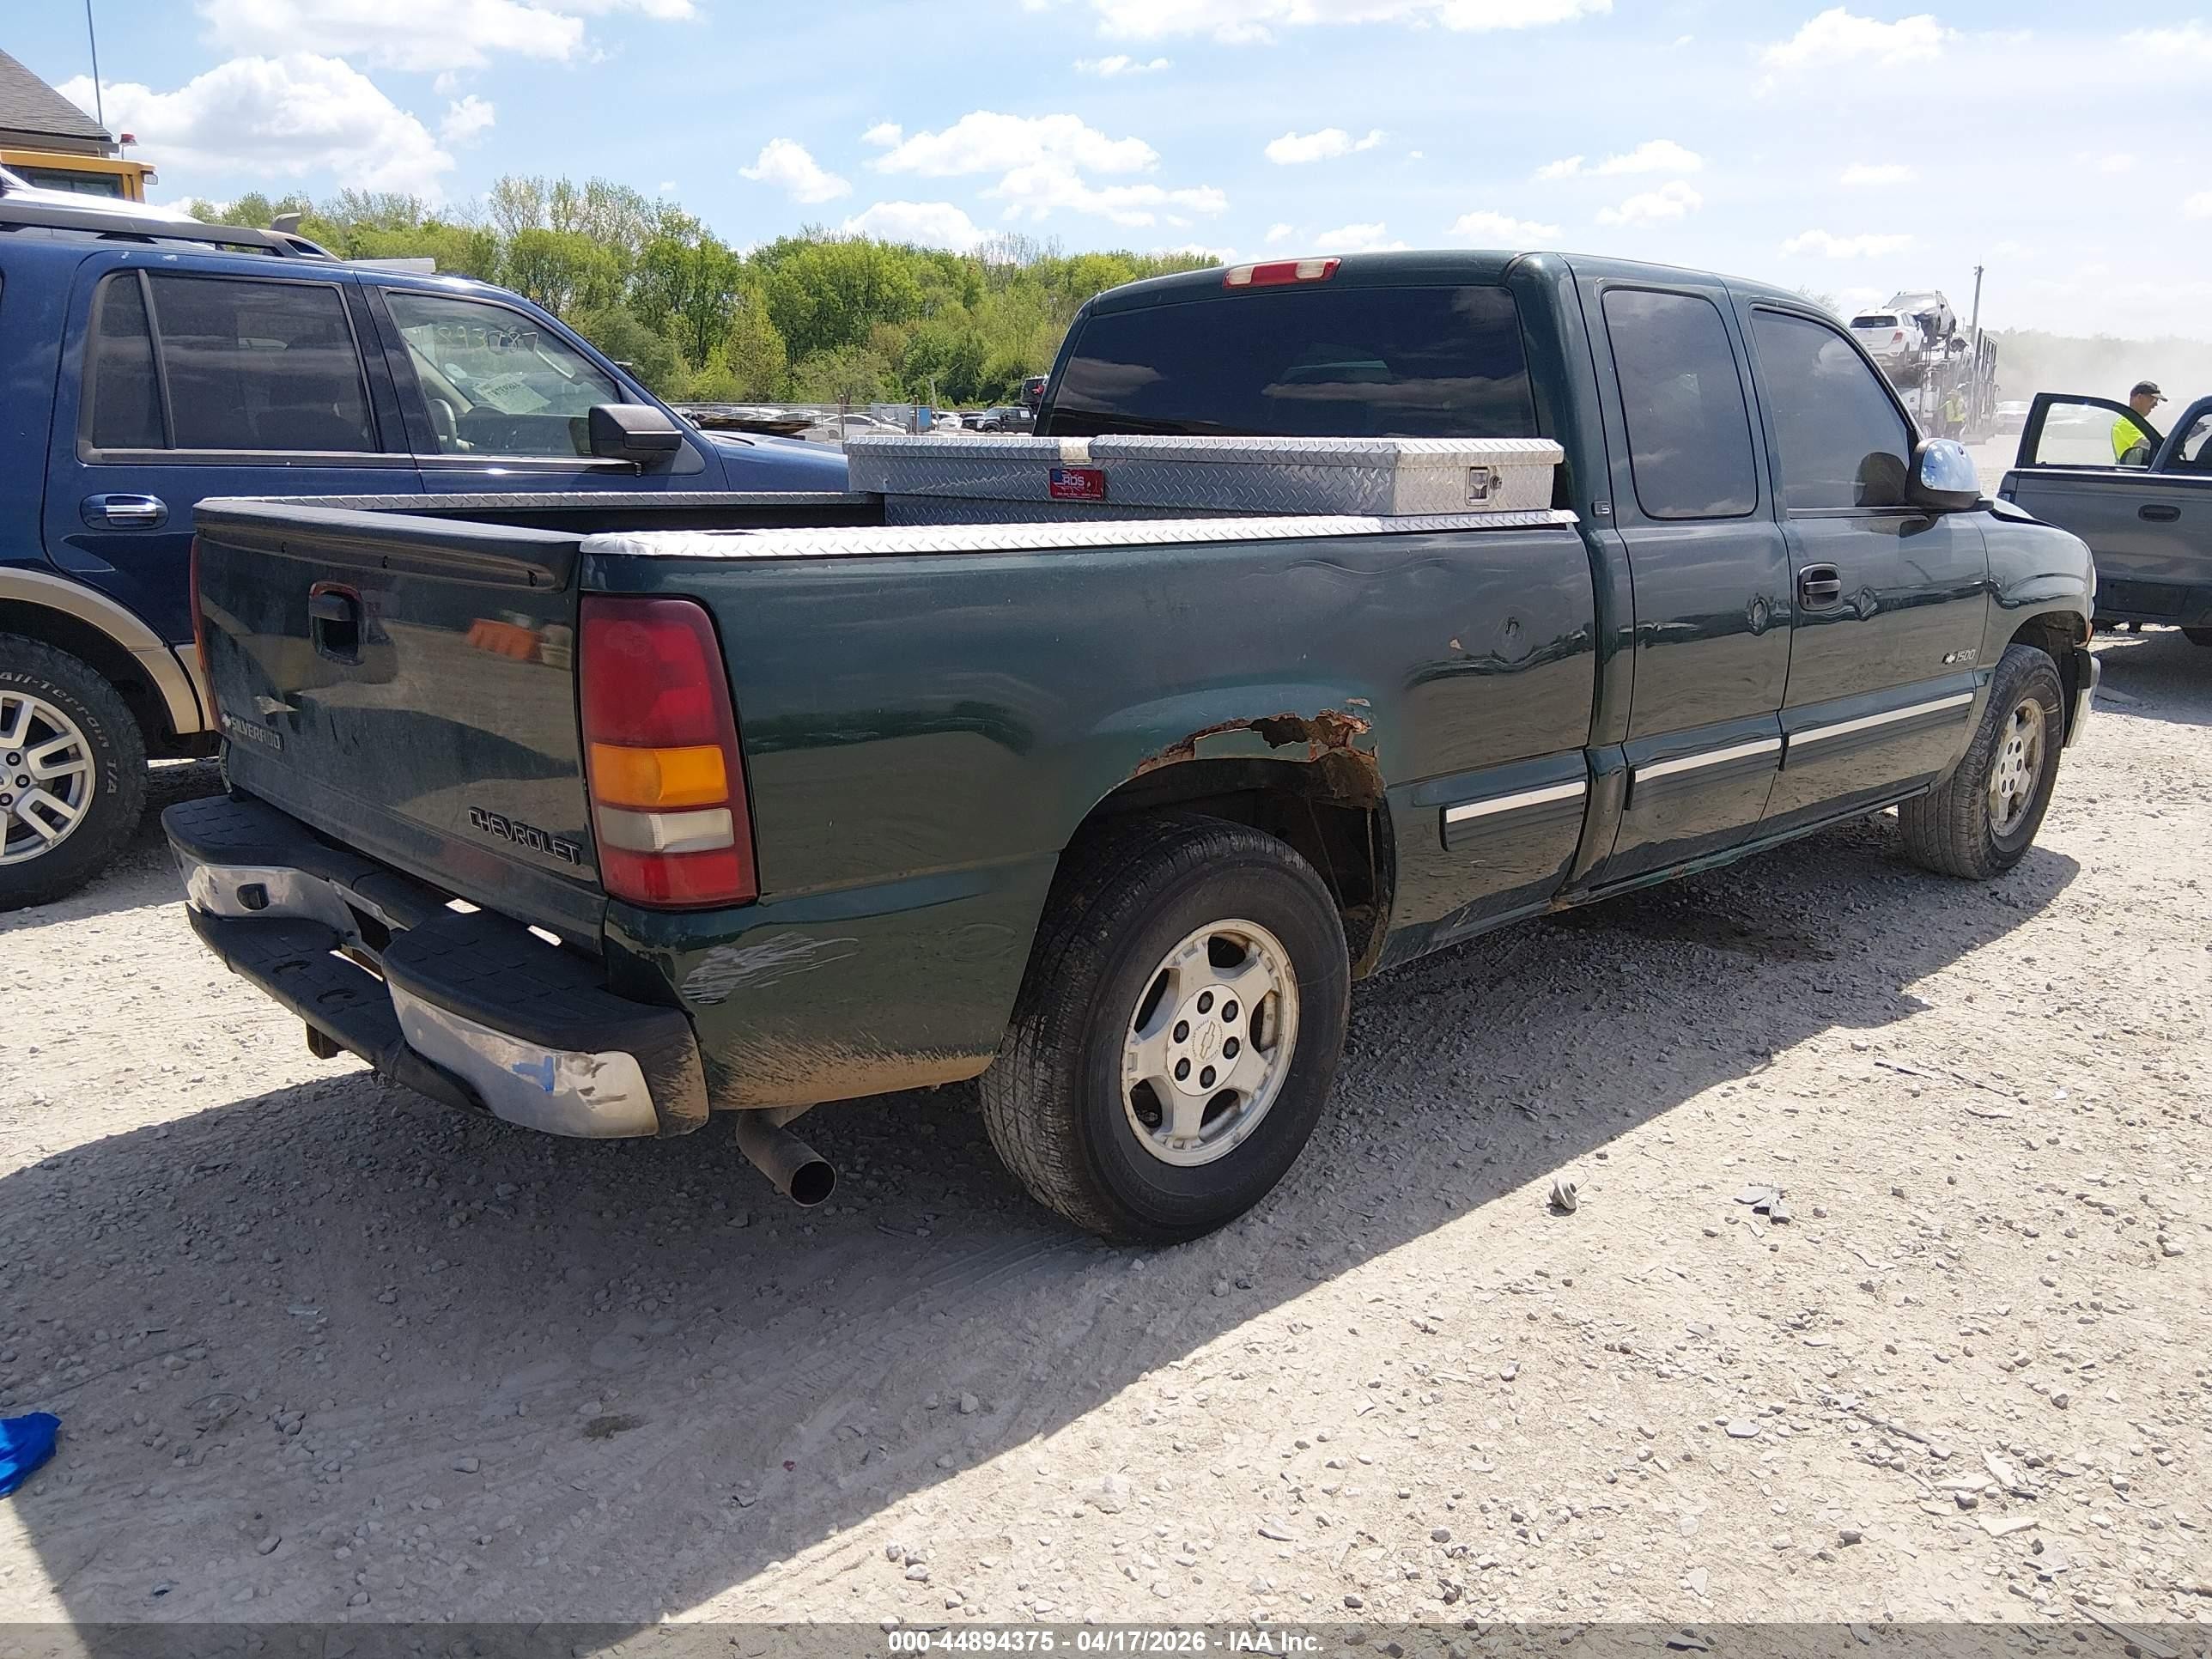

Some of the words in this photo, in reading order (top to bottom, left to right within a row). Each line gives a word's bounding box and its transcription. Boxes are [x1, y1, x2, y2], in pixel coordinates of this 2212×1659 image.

[1956, 648, 1977, 663] 1500
[229, 716, 283, 750] SILVERADO
[106, 758, 118, 793] T/A
[468, 808, 580, 865] CHEVROLET
